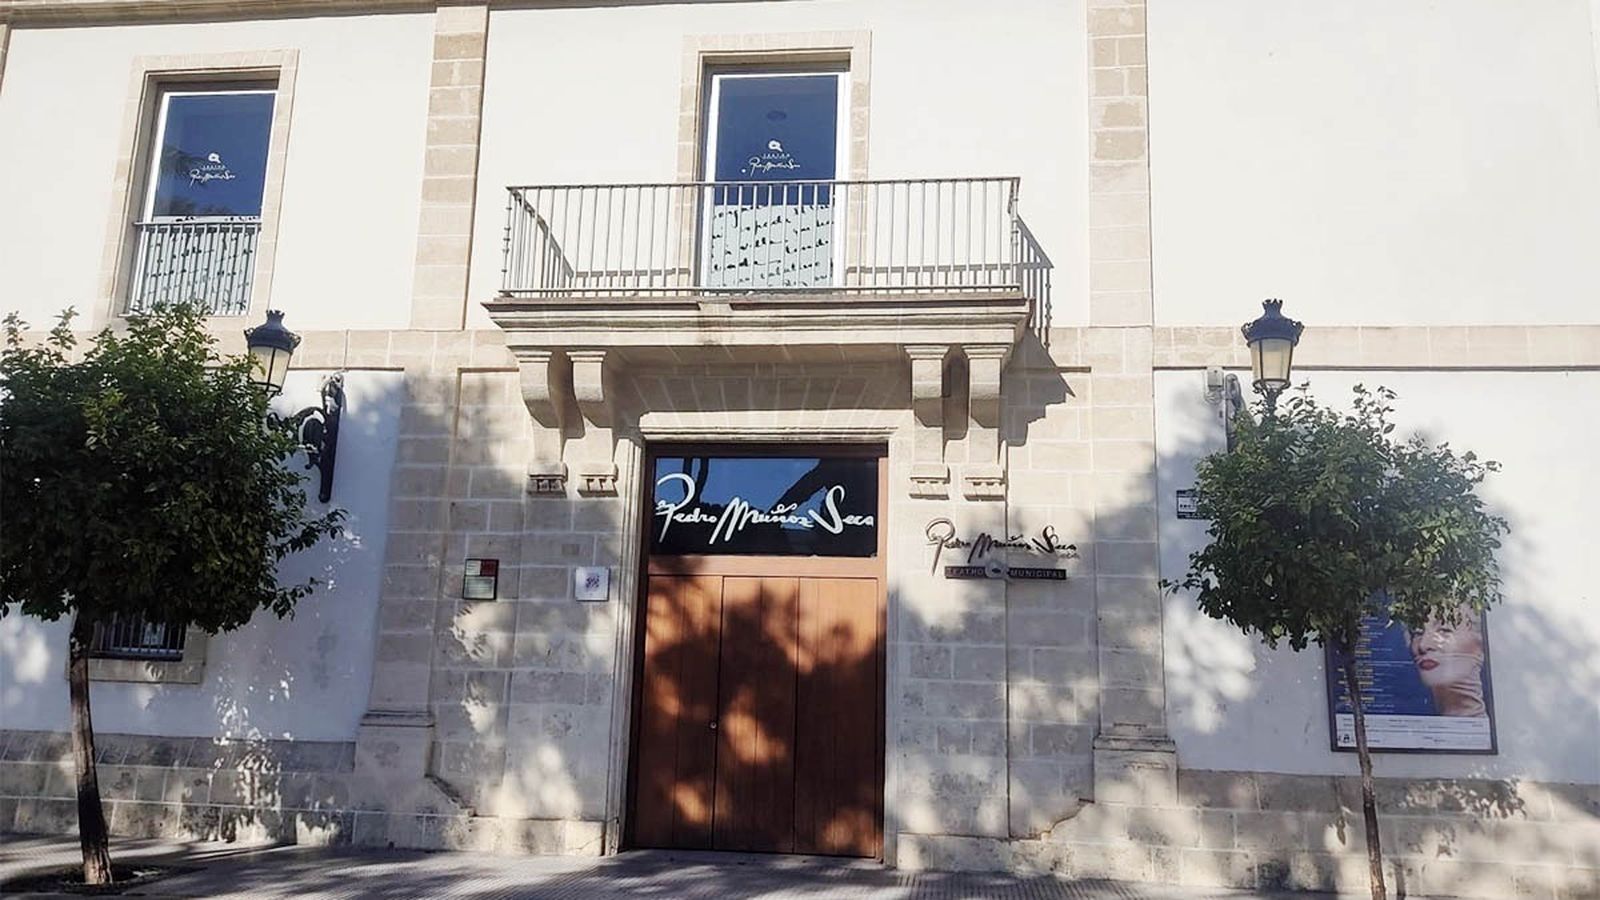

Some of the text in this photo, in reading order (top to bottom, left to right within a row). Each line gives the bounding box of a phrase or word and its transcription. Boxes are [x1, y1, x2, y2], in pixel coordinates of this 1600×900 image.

[655, 473, 874, 545] Pedro Muñoz Seca
[1010, 568, 1065, 578] MUNICIPAL
